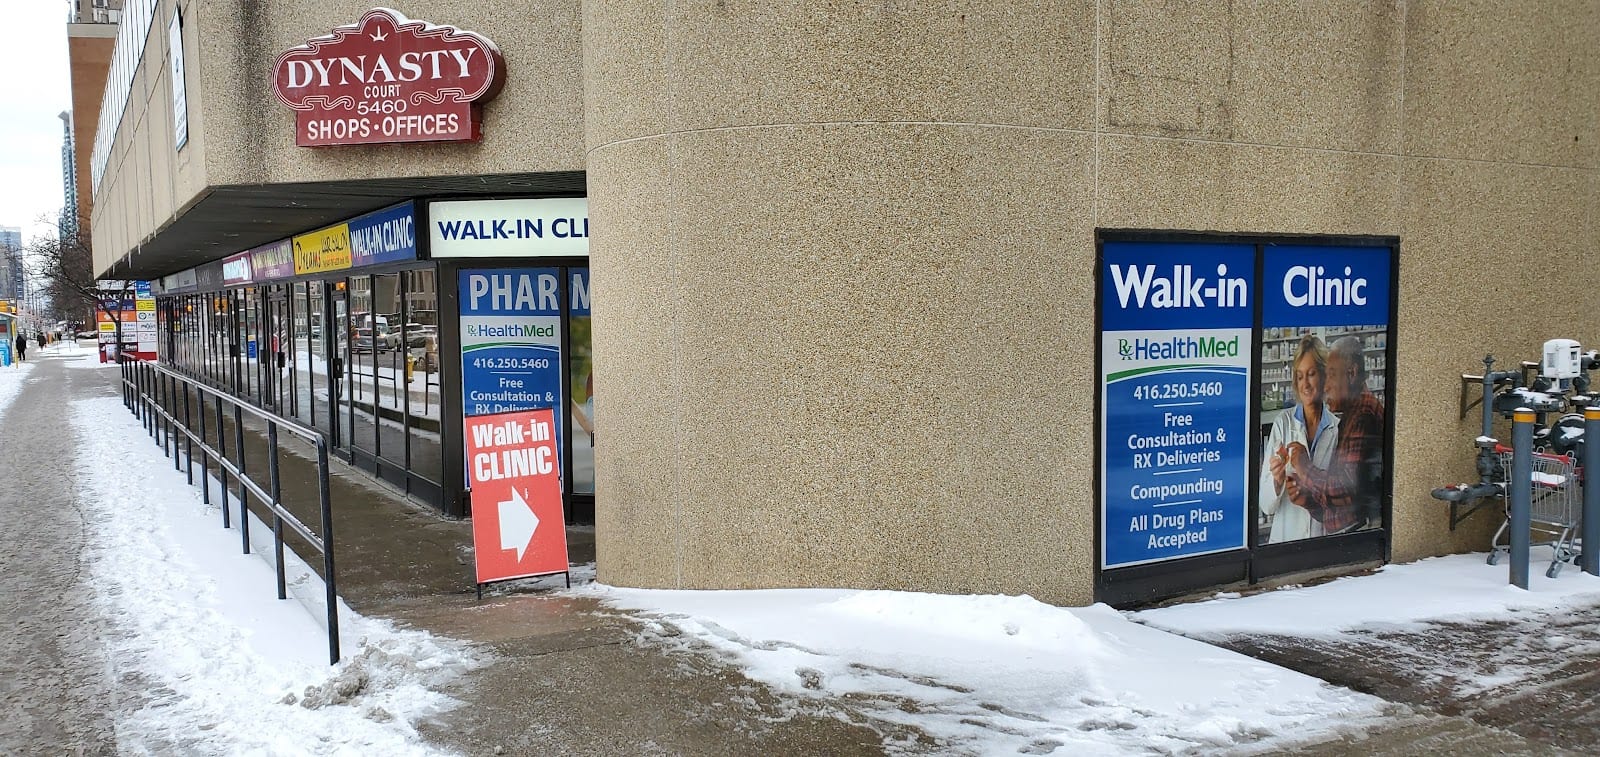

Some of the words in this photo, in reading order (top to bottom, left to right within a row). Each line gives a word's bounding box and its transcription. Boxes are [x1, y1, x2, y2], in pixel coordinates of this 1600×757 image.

[286, 47, 477, 88] DYNASTY
[364, 84, 401, 98] COURT
[357, 100, 406, 115] 5460
[307, 118, 370, 140] SHOPS
[382, 114, 459, 136] OFFICES
[350, 223, 383, 258] WALK-IN
[383, 215, 414, 252] CLINIC
[437, 218, 543, 240] WALK-IN
[1109, 263, 1247, 309] Walk-in
[1282, 265, 1367, 307] Clinic
[478, 324, 554, 337] HealthMed
[1135, 335, 1239, 360] HealthMed
[473, 358, 549, 369] 416.250.5460
[499, 377, 524, 388] Free
[1133, 381, 1223, 401] 416.250.5460
[470, 390, 540, 402] Consultation
[544, 391, 554, 402] &
[475, 404, 490, 414] RX
[1164, 412, 1193, 427] Free
[472, 419, 550, 448] Walk-in
[1127, 431, 1211, 450] Consultation
[1216, 428, 1226, 442] &
[474, 446, 553, 482] CLINIC
[1133, 453, 1152, 469] RX
[1157, 449, 1220, 467] Deliveries
[1130, 477, 1223, 500] Compounding
[1130, 514, 1148, 533] All
[1152, 512, 1185, 531] Drug
[1190, 508, 1224, 525] Plans
[1147, 528, 1208, 550] Accepted
